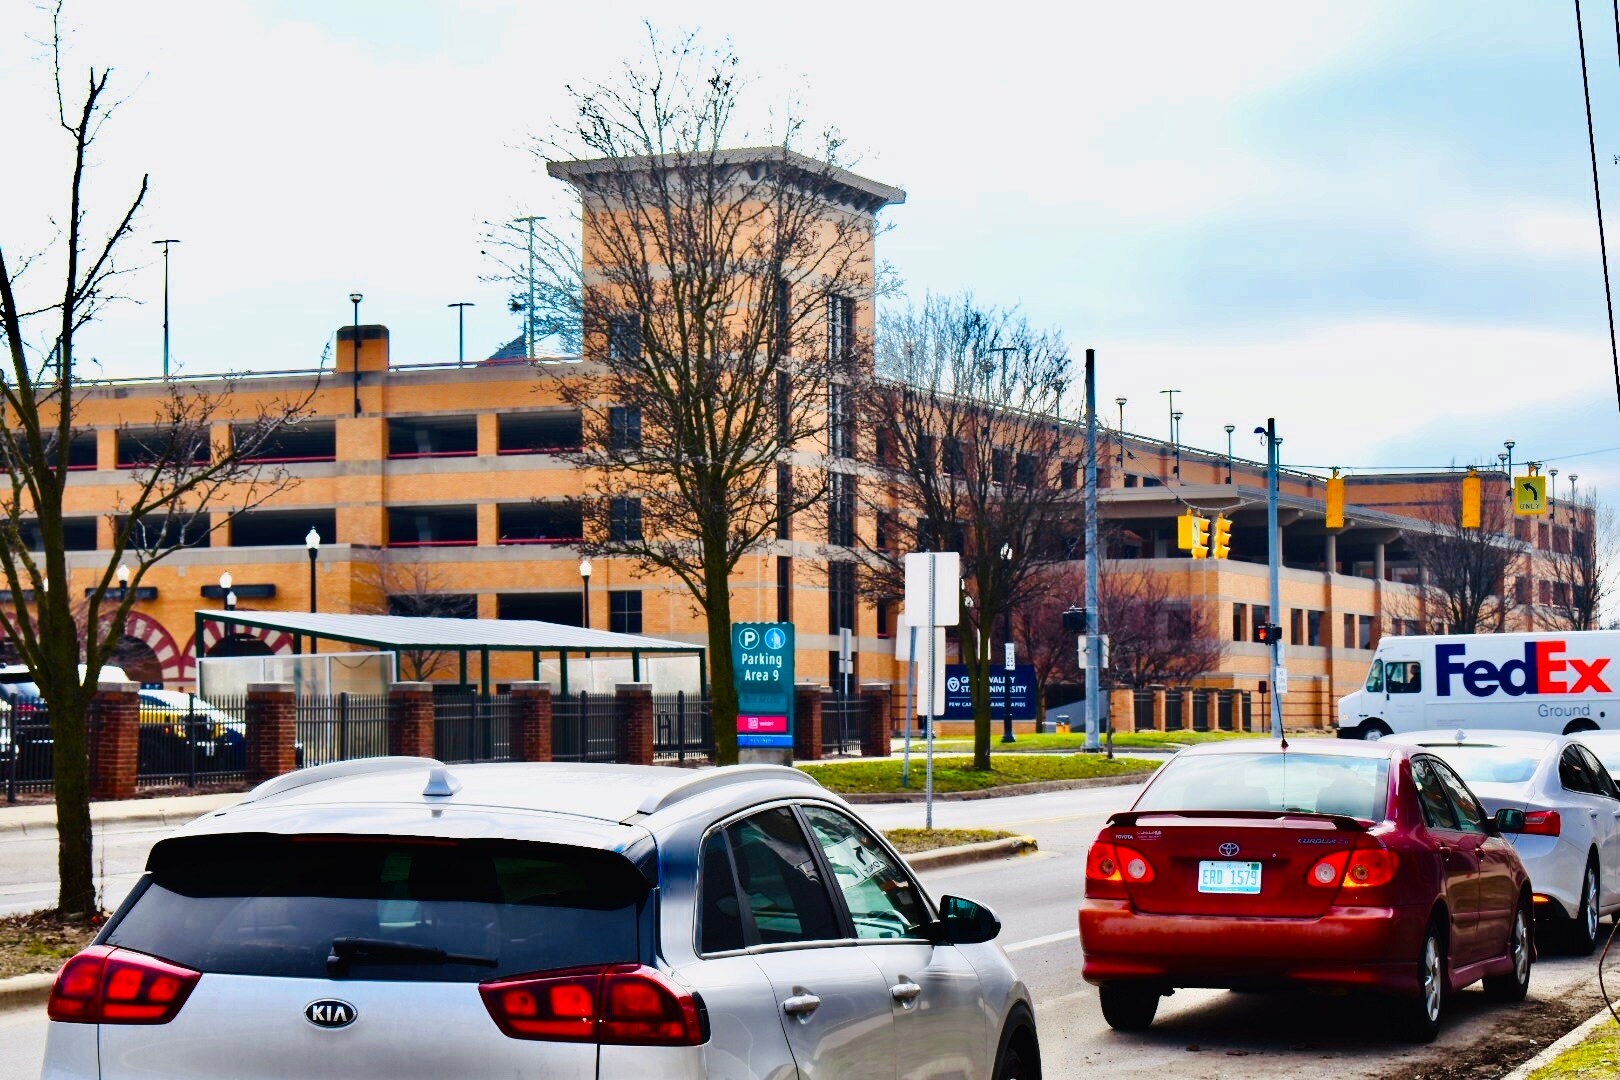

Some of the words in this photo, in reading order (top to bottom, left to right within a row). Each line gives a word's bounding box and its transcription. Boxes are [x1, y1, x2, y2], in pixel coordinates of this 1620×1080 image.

[741, 653, 782, 668] Parking
[744, 670, 769, 681] Area
[773, 670, 779, 681] 9
[1435, 641, 1613, 697] FedEx
[1538, 704, 1590, 717] Ground
[1203, 869, 1223, 885] ERD
[1231, 870, 1257, 886] 1579
[312, 1005, 348, 1022] KIA
